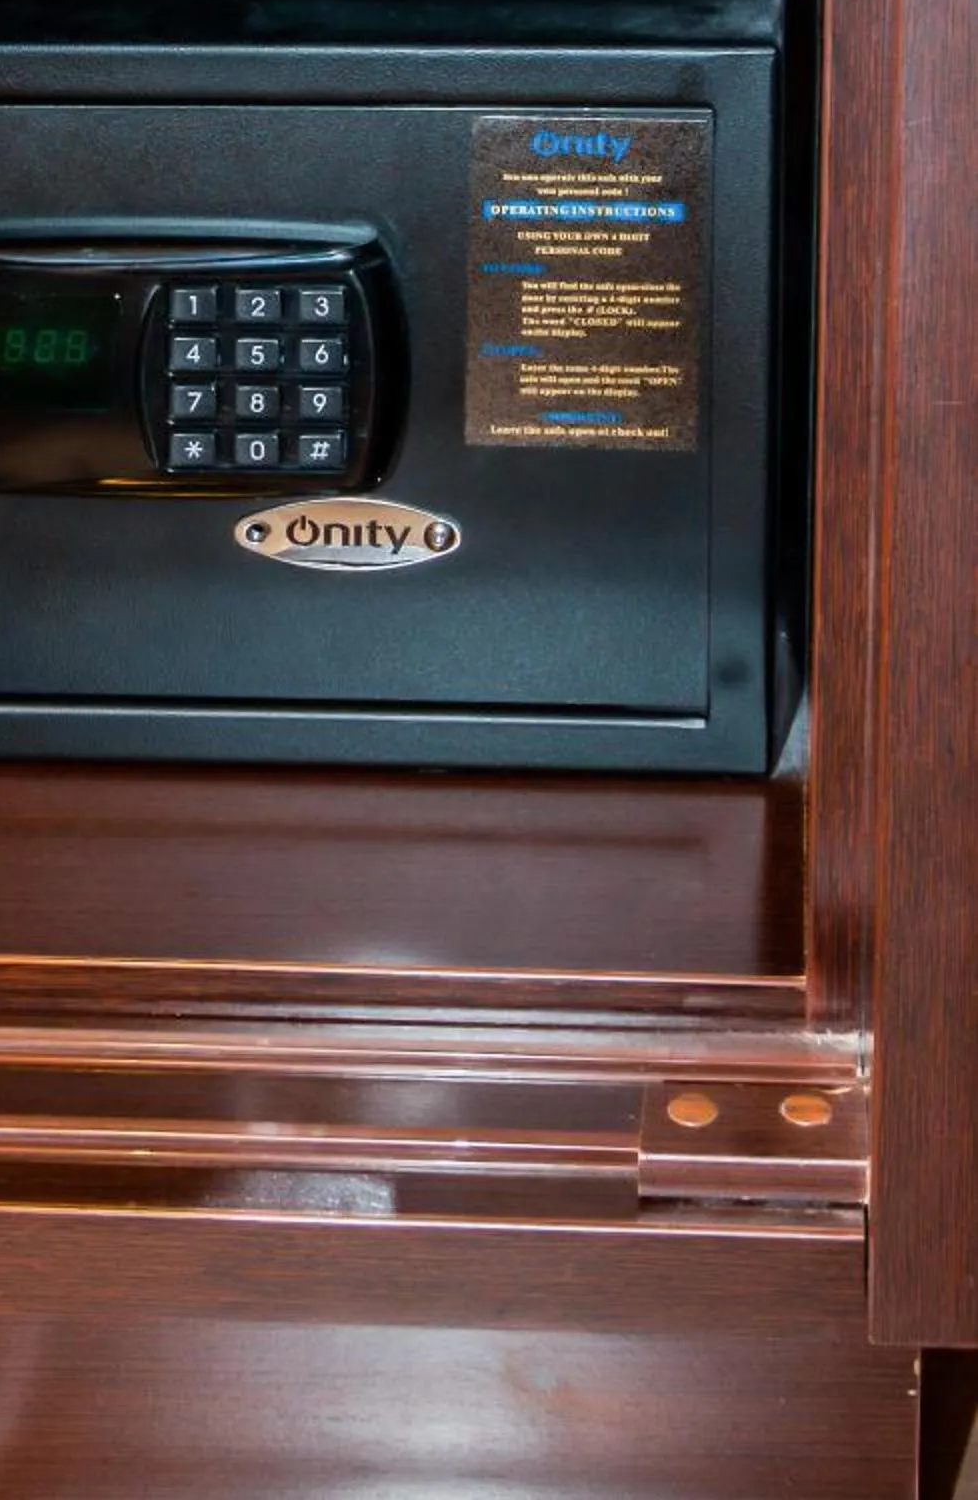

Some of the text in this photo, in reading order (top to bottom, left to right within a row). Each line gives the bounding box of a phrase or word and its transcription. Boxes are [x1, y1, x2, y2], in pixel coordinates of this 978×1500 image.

[491, 204, 675, 218] OPERATING INSTRUCTIONS
[552, 232, 583, 241] YOUR
[188, 295, 330, 317] 1 2 3
[185, 344, 329, 365] 4 5 6
[187, 391, 327, 413] 7 8 9
[250, 440, 266, 461] 0
[285, 515, 411, 555] Onity
